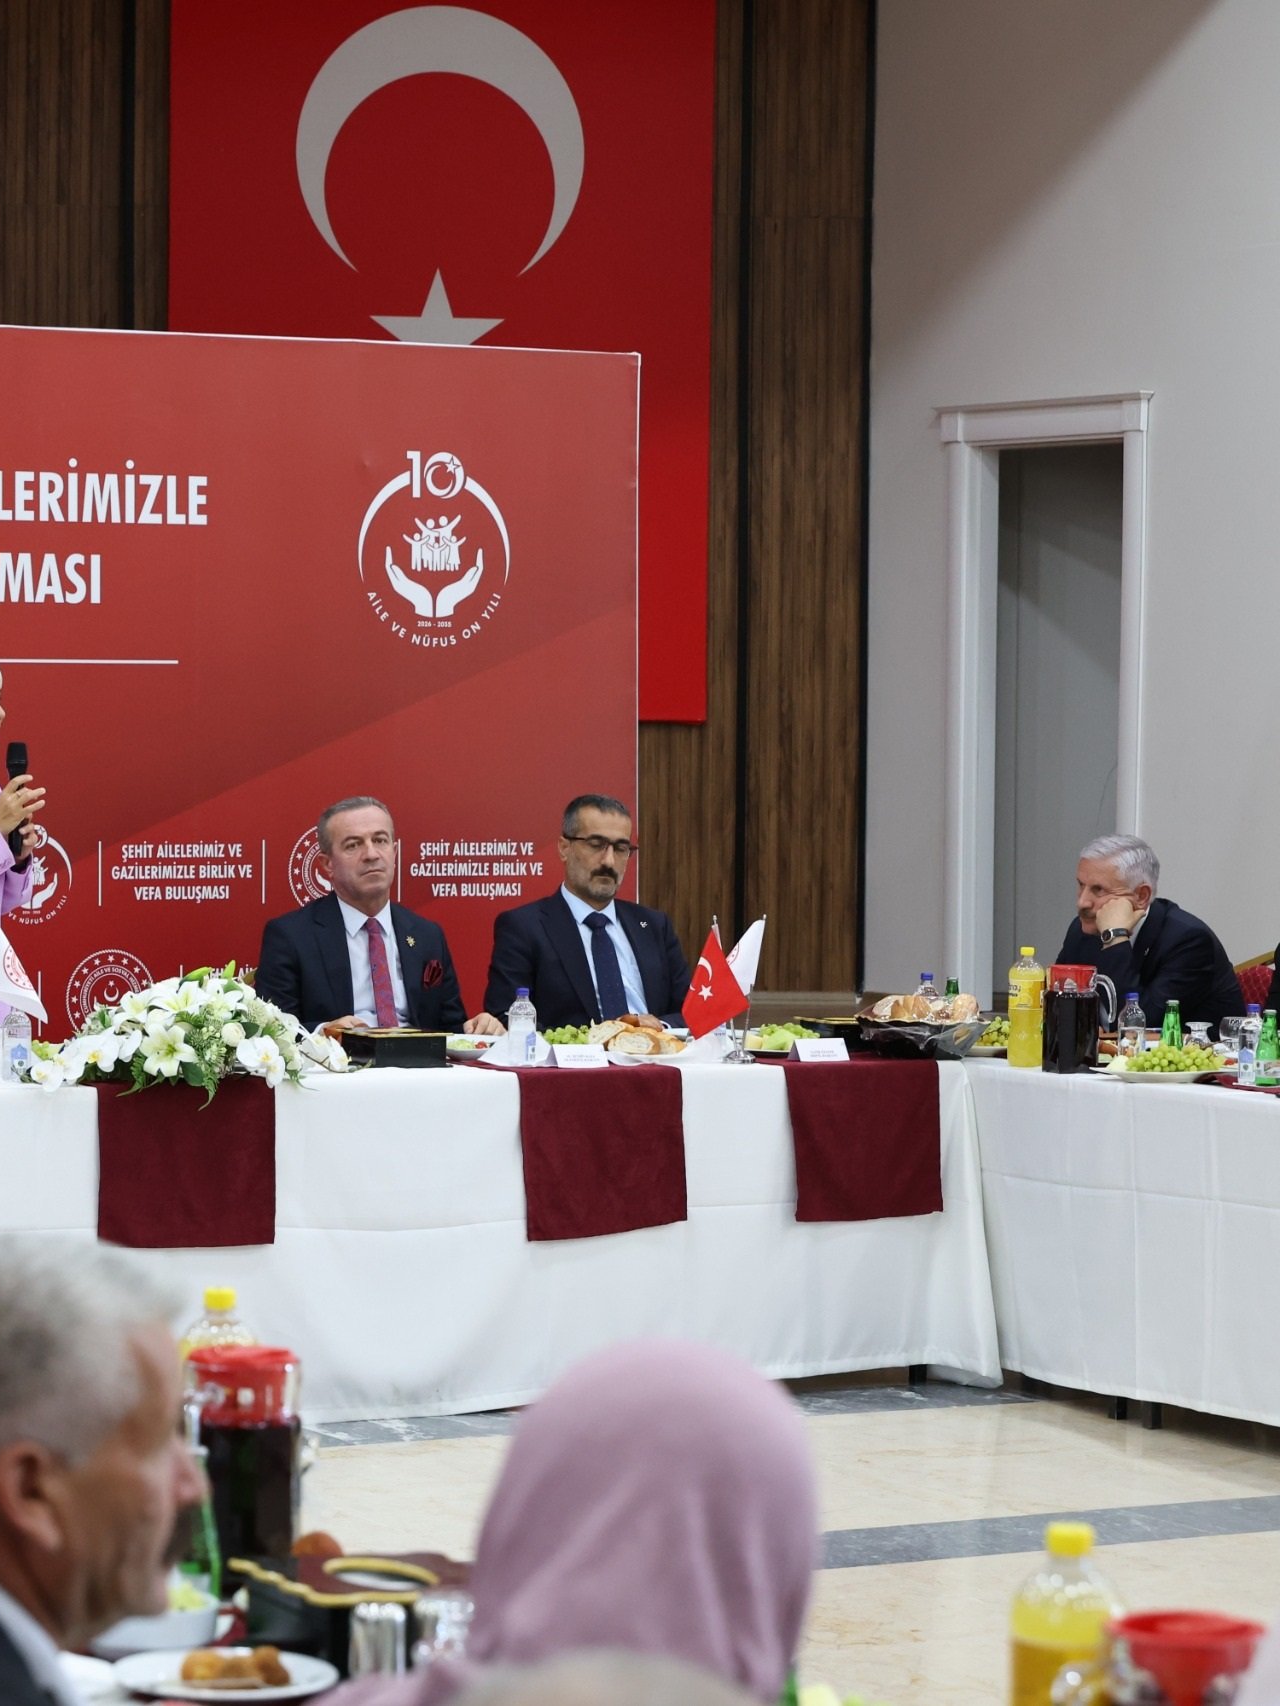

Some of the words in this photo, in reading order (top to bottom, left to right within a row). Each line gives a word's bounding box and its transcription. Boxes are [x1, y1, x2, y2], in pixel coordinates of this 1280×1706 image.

[367, 592, 389, 621] AİLE
[392, 622, 406, 638] VE
[412, 634, 456, 647] NÜFUS
[462, 622, 480, 638] ON
[482, 592, 500, 620] YILI
[122, 841, 153, 862] ŞEHİT
[157, 841, 224, 858] AİLELERİMİZ
[228, 844, 242, 857] VE
[420, 839, 450, 859] ŞEHİT
[453, 839, 517, 856] AİLELERİMİZ
[520, 842, 533, 855] VE
[112, 862, 195, 879] GAZİLERİMİZLE
[199, 861, 235, 878] BİRLİK
[238, 865, 252, 878] VE
[411, 860, 489, 876] GAZİLERİMİZLE
[493, 859, 527, 876] BİRLİK
[530, 862, 542, 875] VE
[134, 887, 162, 900] VEFA
[166, 886, 229, 903] BULUŞMASI
[432, 884, 457, 896] VEFA
[461, 883, 521, 900] BULUŞMASI
